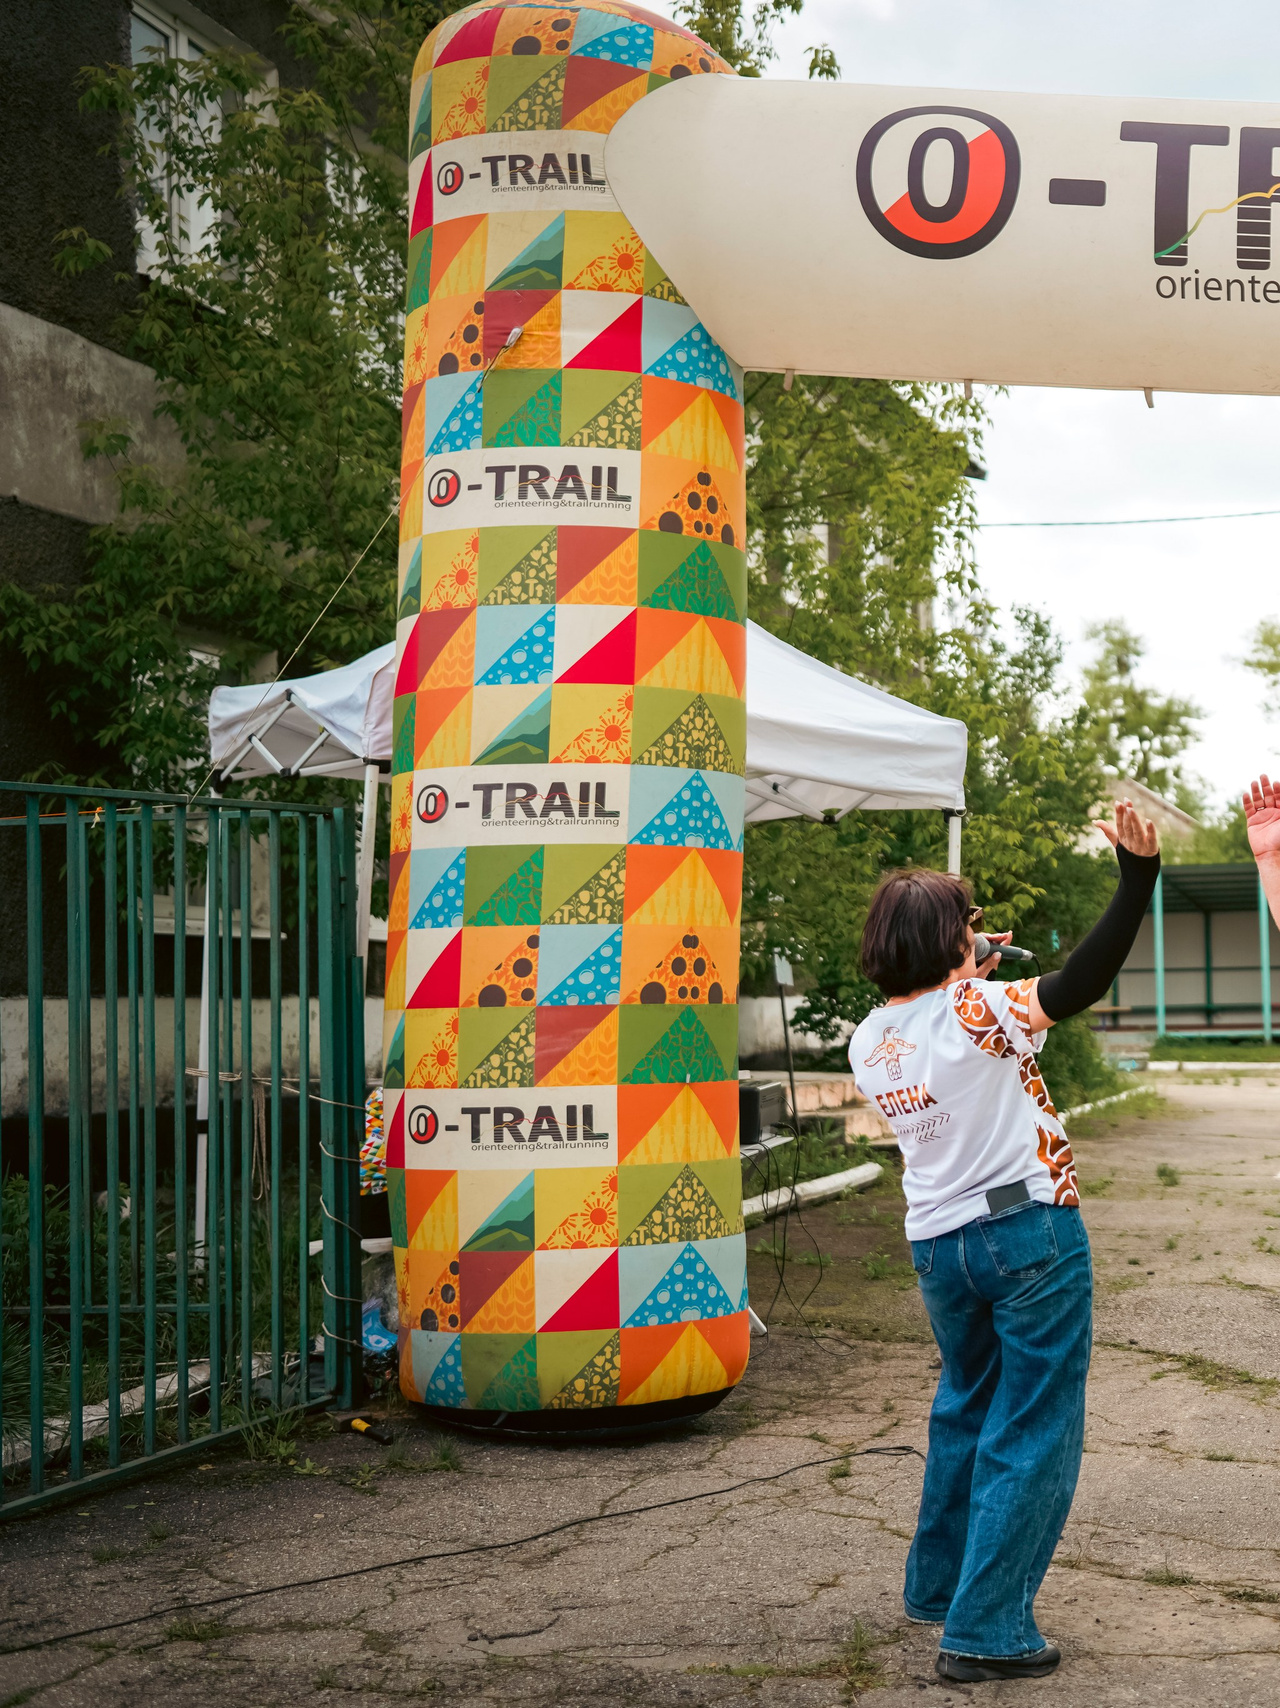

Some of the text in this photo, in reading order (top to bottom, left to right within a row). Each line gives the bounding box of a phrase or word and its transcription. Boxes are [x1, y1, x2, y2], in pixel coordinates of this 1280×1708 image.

[491, 183, 606, 194] orienteering&trailrunning
[494, 499, 632, 511] orienteering&trailrunning
[481, 817, 620, 827] orienteering&trailrunning
[875, 1083, 938, 1117] ЕЛЕНА
[471, 1140, 609, 1152] orienteering&trailrunning
